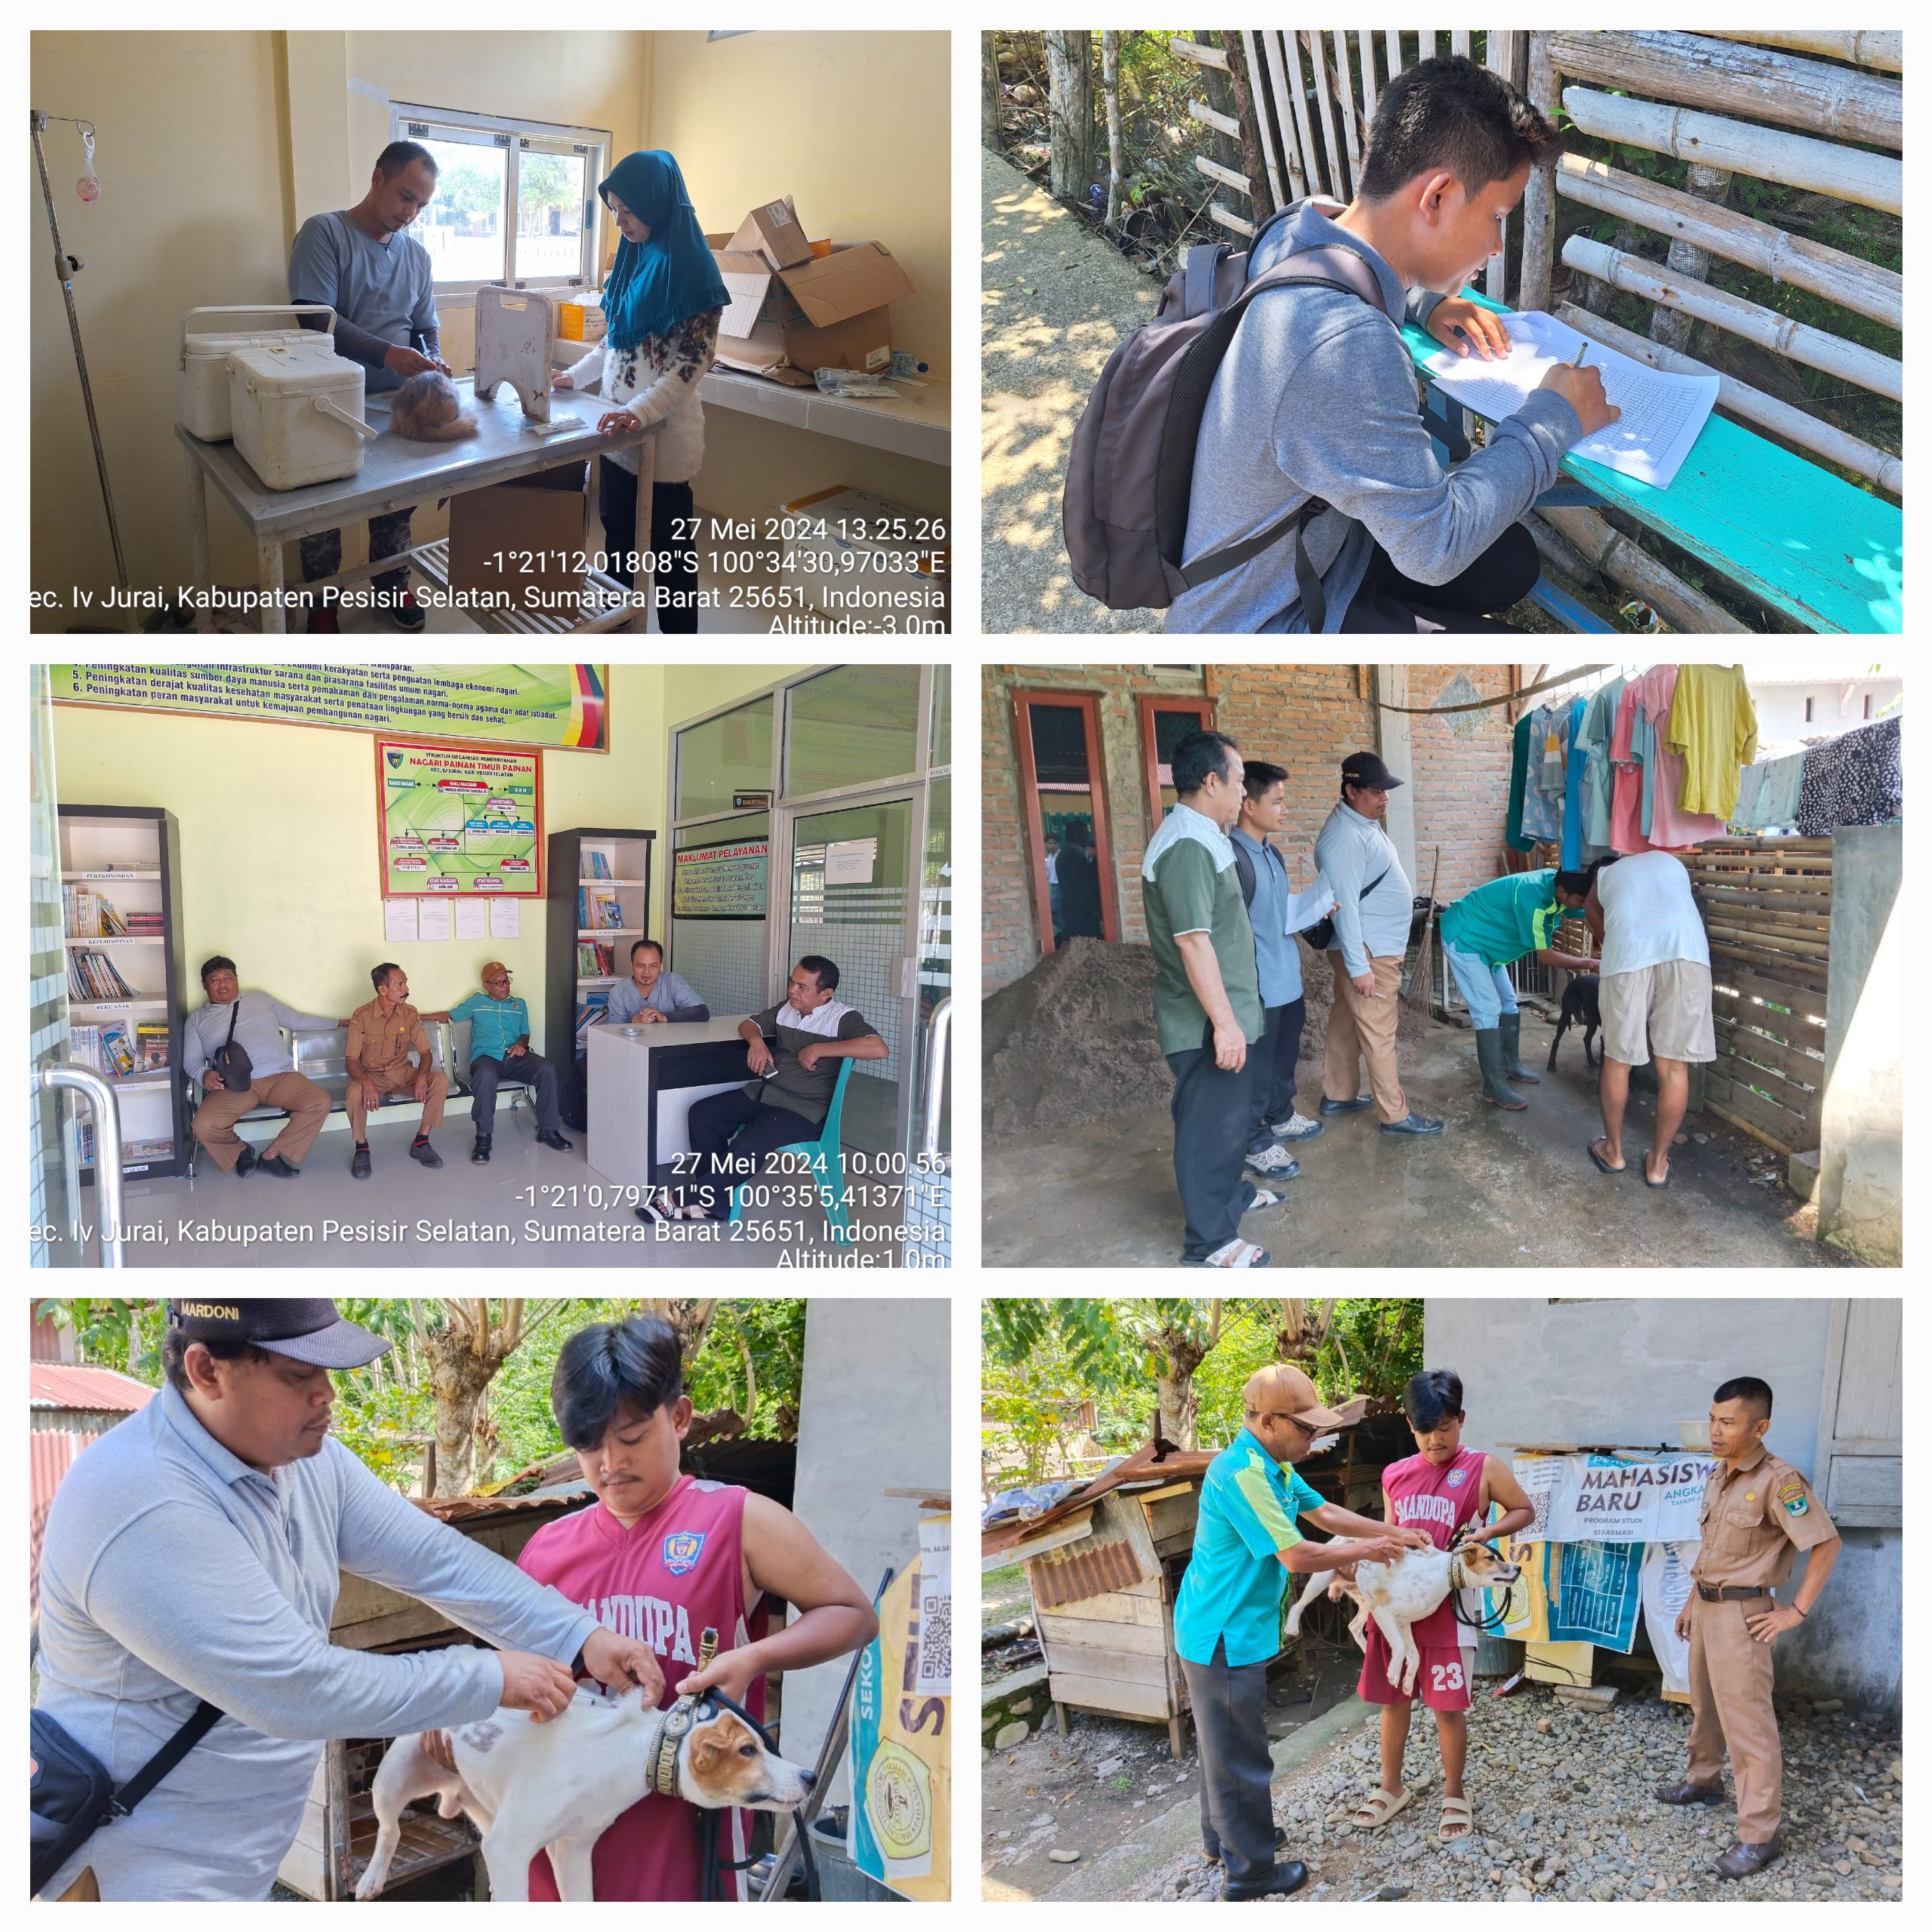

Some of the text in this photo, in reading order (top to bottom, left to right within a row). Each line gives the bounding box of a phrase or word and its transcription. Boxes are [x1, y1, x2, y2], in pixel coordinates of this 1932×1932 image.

[150, 666, 187, 678] kualitas
[190, 672, 223, 682] sumber
[225, 674, 247, 684] daya
[250, 679, 285, 688] manusia
[288, 682, 309, 691] serta
[312, 686, 360, 697] pemahaman
[362, 691, 376, 700] dan
[379, 694, 424, 705] pengalaman
[427, 700, 474, 710] norma-norma
[476, 705, 498, 713] agama
[500, 706, 513, 714] dan
[531, 710, 557, 719] istiadat.
[217, 664, 272, 676] infrastruktur
[274, 669, 303, 679] sarana
[307, 673, 321, 682] dan
[324, 676, 364, 688] prasarana
[366, 680, 397, 691] fasilitas
[399, 686, 421, 694] umum
[423, 689, 448, 698] nagari.
[325, 664, 368, 677] kerakyatan
[371, 671, 390, 680] serta
[393, 674, 431, 685] penguatan
[434, 678, 464, 690] lembaga
[466, 682, 494, 692] ekonomi
[496, 687, 519, 696] nagari.
[72, 670, 506, 724] 5. Peningkatan derajat kualitas kesehatan masyarakat serta penataan lingkungan yang bersih dan sehat.
[72, 682, 392, 723] 6. Peningkatan peran masyarakat untuk kemajuan pembangunan nagari.
[410, 757, 532, 773] NAGARI PAINAN TIMUR PAINAN
[678, 844, 767, 863] MAKLUMAT PELAYANAN
[181, 1301, 239, 1320] MARDONI
[1580, 1460, 1717, 1491] MAHASISW
[1576, 1491, 1642, 1513] BARU
[1671, 1497, 1695, 1507] TAHUN
[1431, 1662, 1463, 1691] 23
